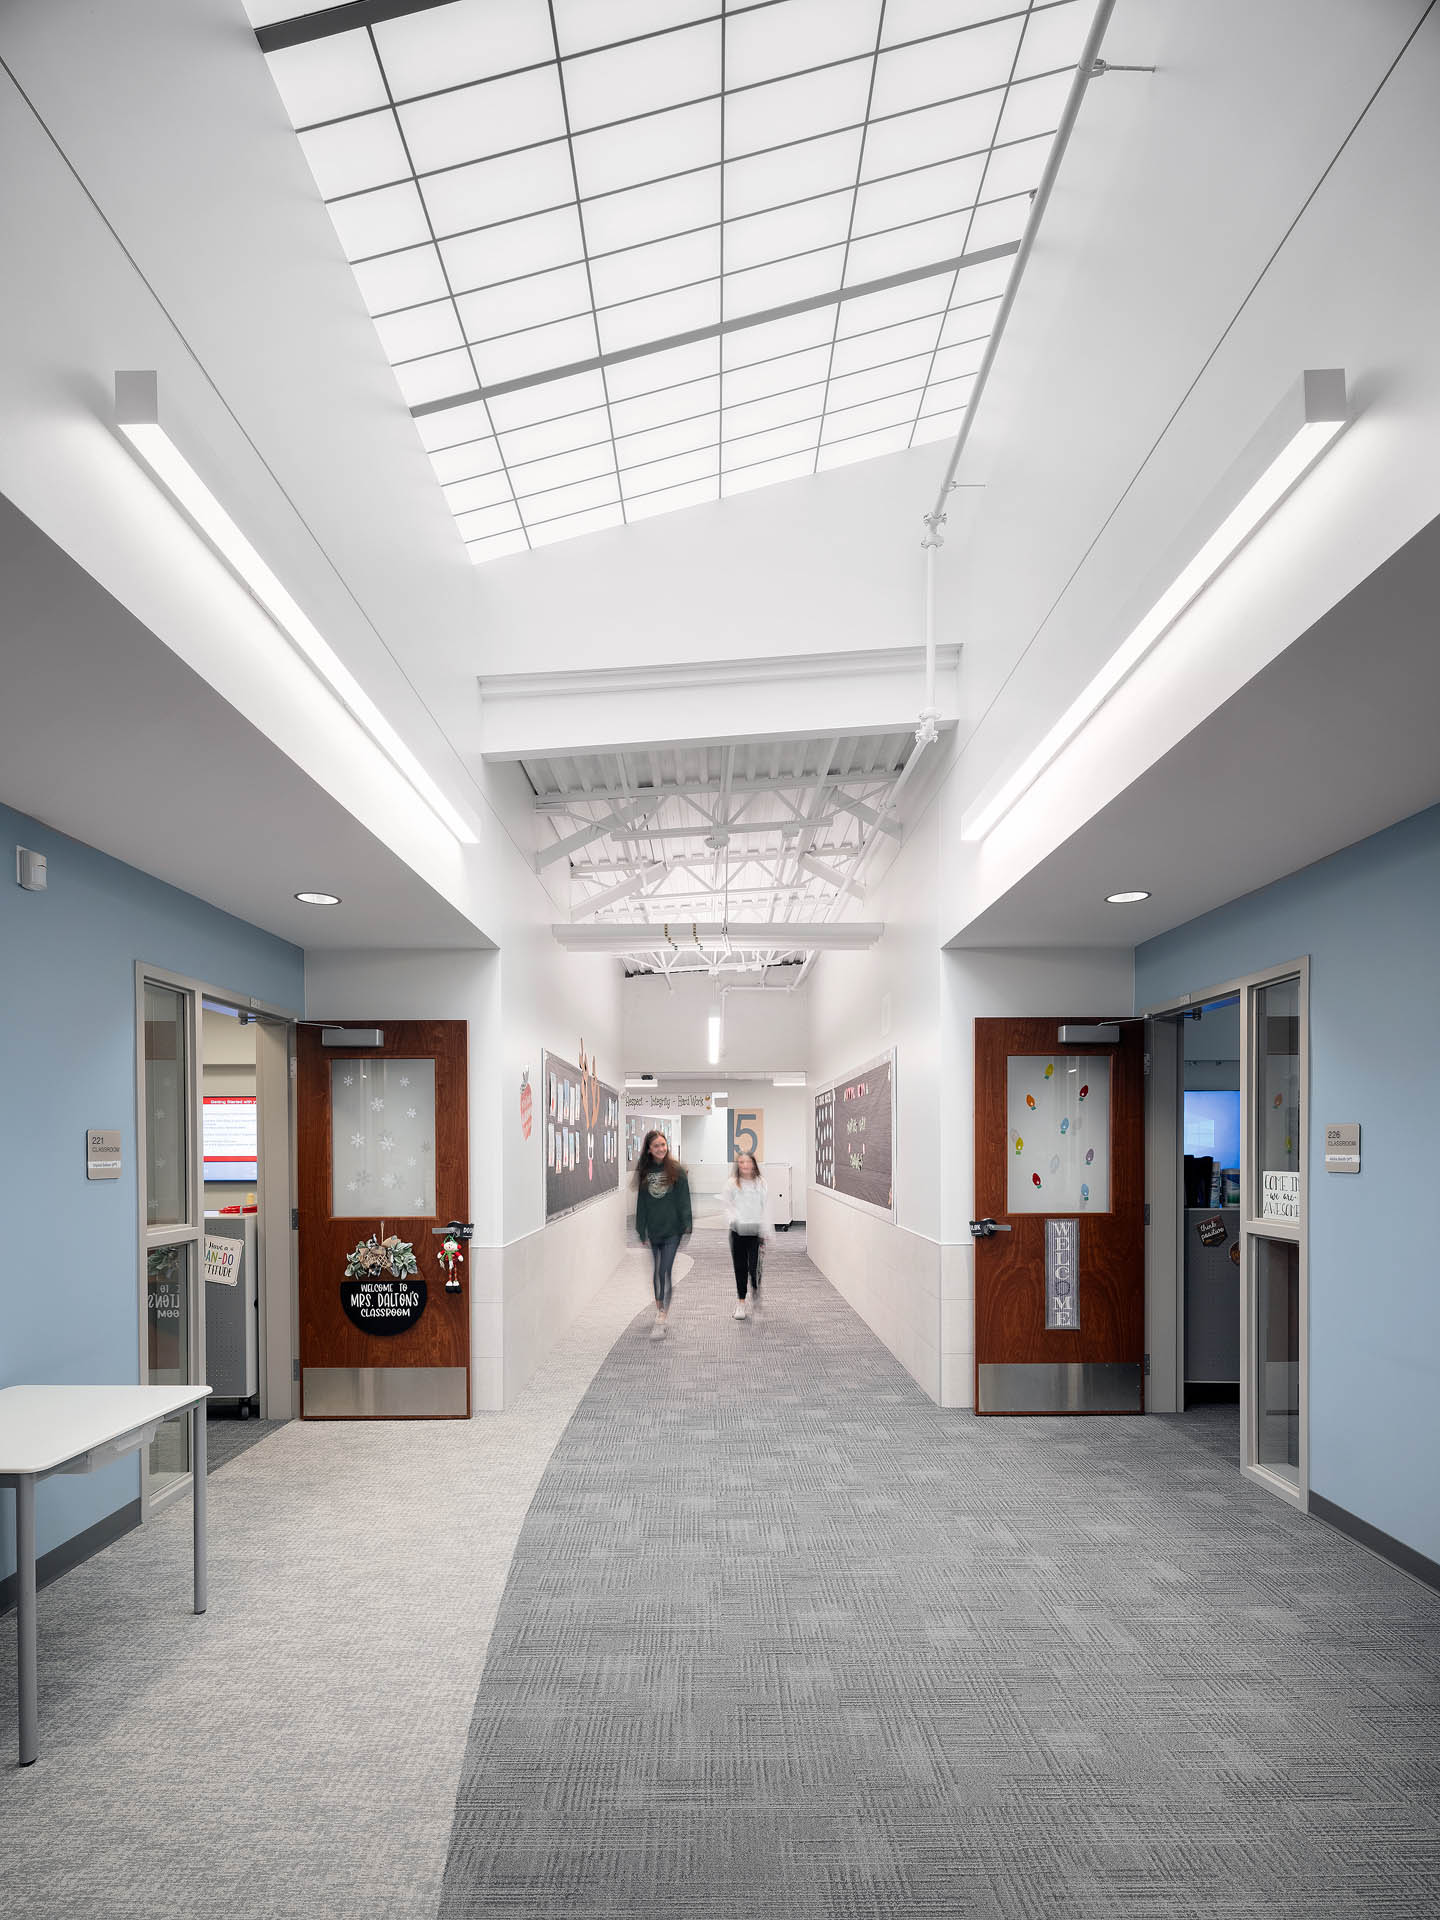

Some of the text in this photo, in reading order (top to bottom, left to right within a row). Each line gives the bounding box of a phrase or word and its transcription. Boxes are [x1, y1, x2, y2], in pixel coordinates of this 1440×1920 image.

[625, 1096, 643, 1110] Respect
[650, 1096, 671, 1109] Integrity
[677, 1096, 690, 1107] Hard
[690, 1095, 704, 1107] Work
[733, 1113, 758, 1154] 5
[1328, 1130, 1341, 1139] 226
[91, 1136, 104, 1145] 221
[1264, 1174, 1288, 1192] COME
[1200, 1220, 1217, 1231] think
[208, 1241, 224, 1251] Have
[205, 1249, 234, 1266] AN-DO
[204, 1263, 233, 1278] TITUDE
[360, 1283, 408, 1292] WELCOME TO
[350, 1291, 420, 1308] MRS. DALTON'S
[360, 1307, 411, 1318] CLASSROOM
